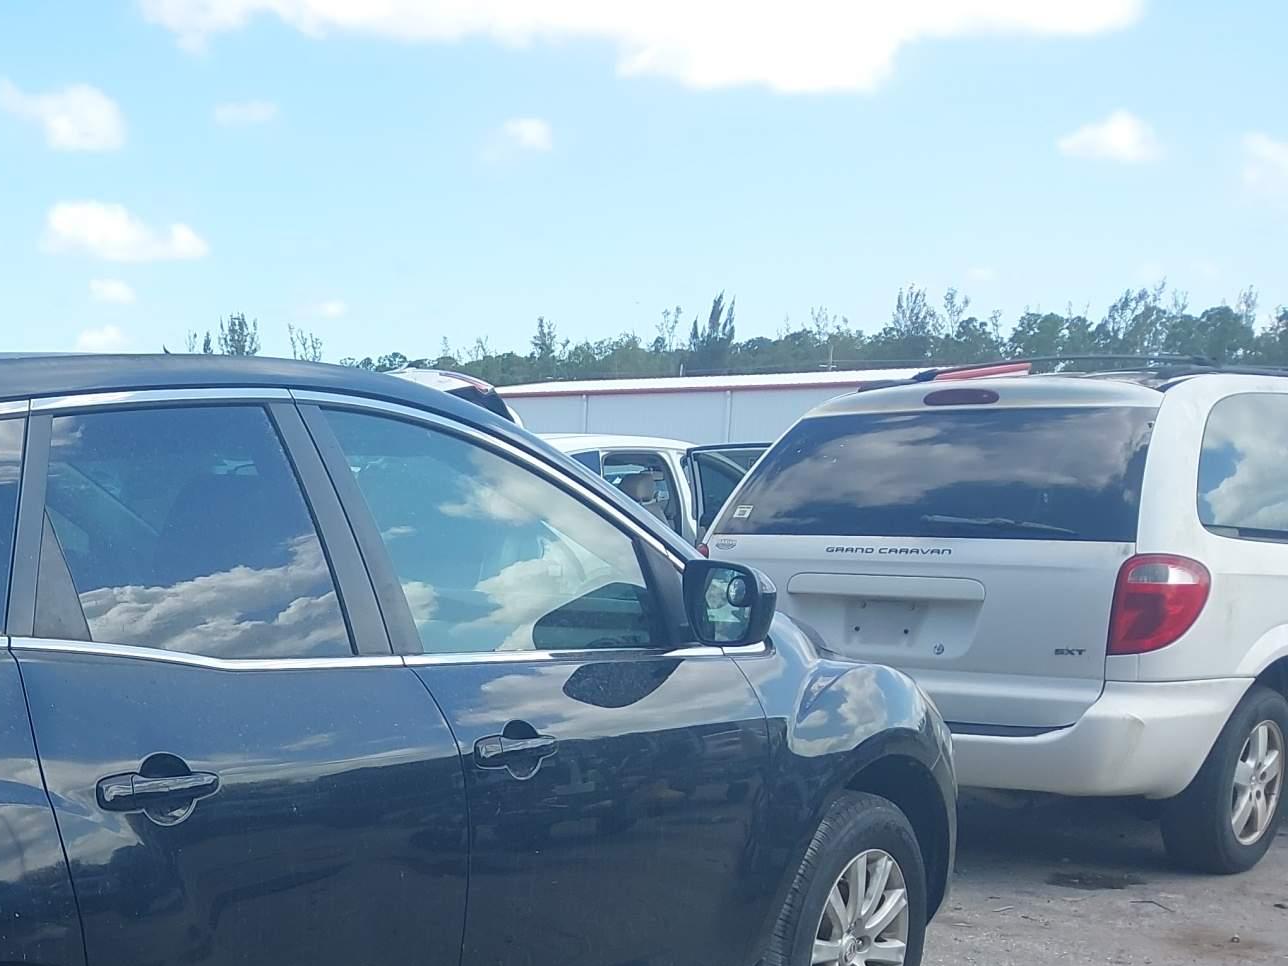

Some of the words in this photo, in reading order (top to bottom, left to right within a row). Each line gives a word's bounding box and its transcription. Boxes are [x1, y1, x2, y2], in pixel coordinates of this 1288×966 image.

[825, 546, 874, 554] GRAND
[878, 547, 952, 555] CARAVAN
[1054, 648, 1086, 656] SXT
